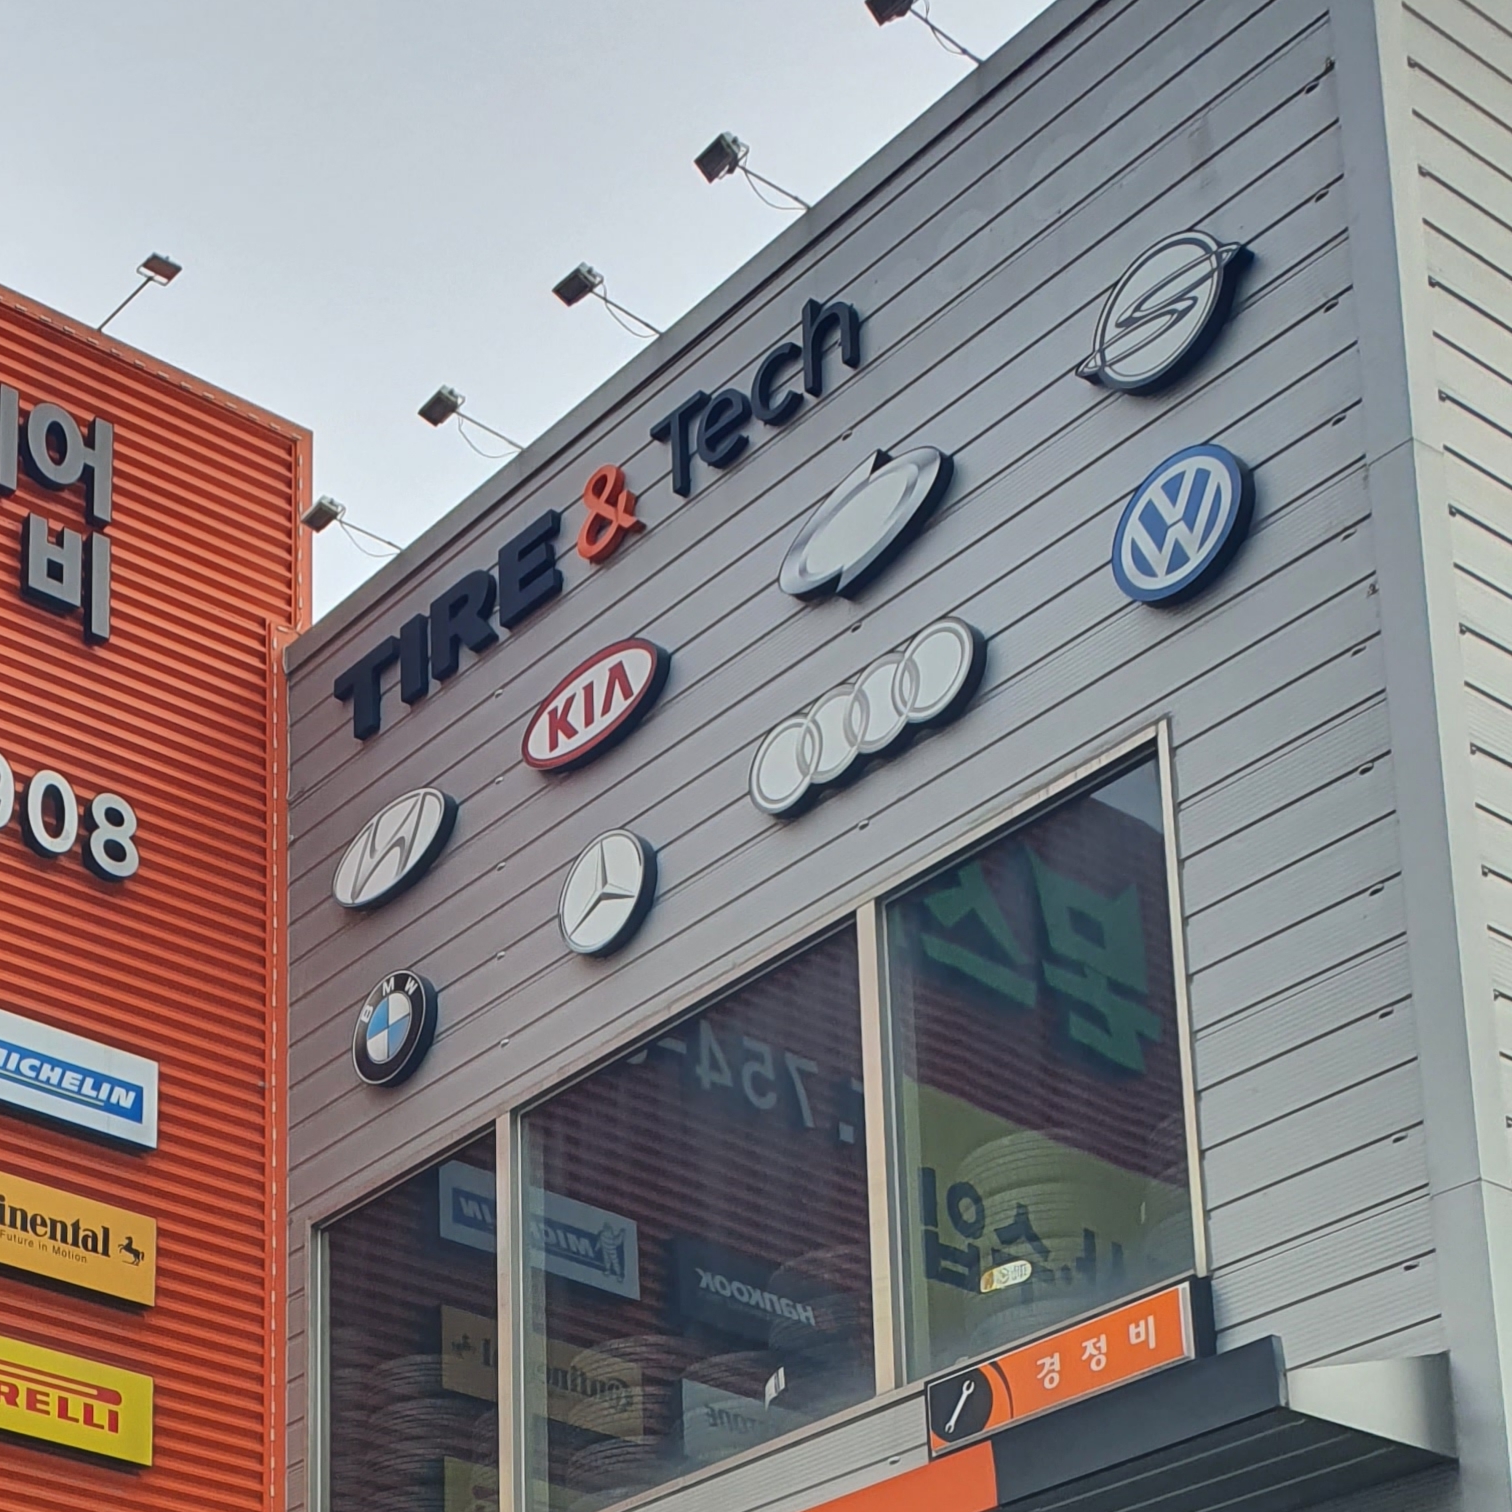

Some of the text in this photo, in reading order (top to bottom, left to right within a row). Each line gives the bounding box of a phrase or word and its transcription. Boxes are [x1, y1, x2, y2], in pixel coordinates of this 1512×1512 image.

[334, 297, 862, 741] TIRE & Tech
[547, 659, 634, 753] KIA
[360, 976, 419, 1024] BMW
[38, 1240, 49, 1252] in
[51, 1245, 88, 1264] Motion
